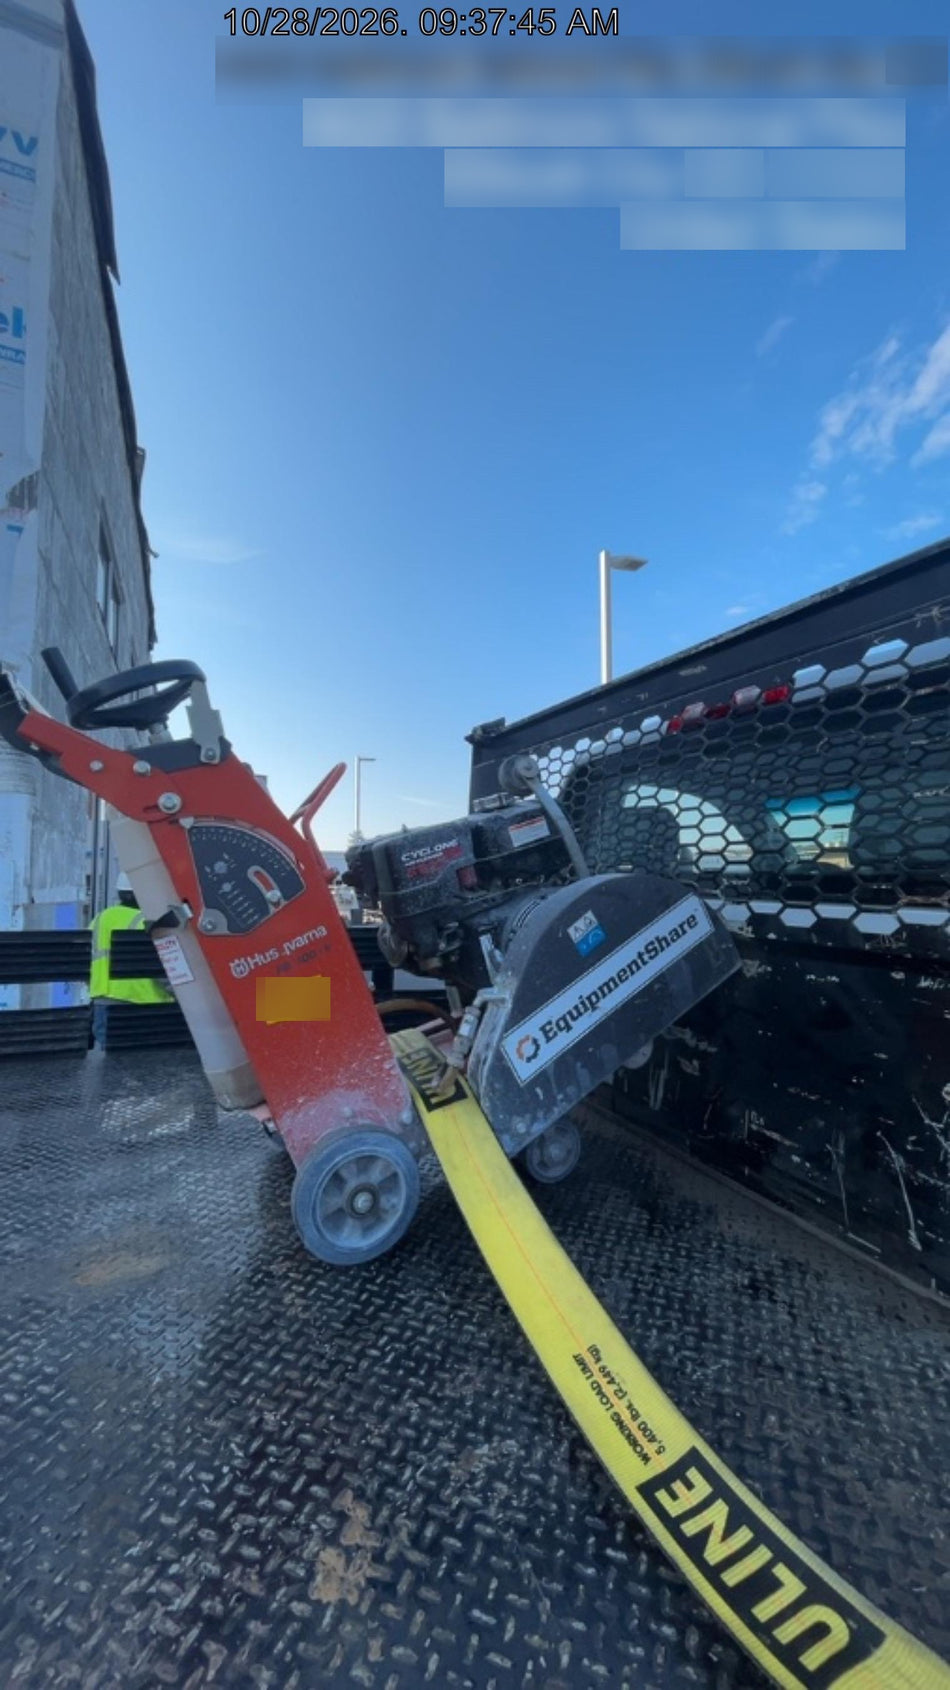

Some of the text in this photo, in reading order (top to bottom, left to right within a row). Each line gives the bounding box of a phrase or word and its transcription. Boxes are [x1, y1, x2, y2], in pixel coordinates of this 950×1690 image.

[539, 913, 699, 1043] EquipmentShare
[572, 1353, 652, 1466] WORKING LOAD LIMIT
[638, 1420, 666, 1456] 5,400
[653, 1465, 851, 1672] ULINE
